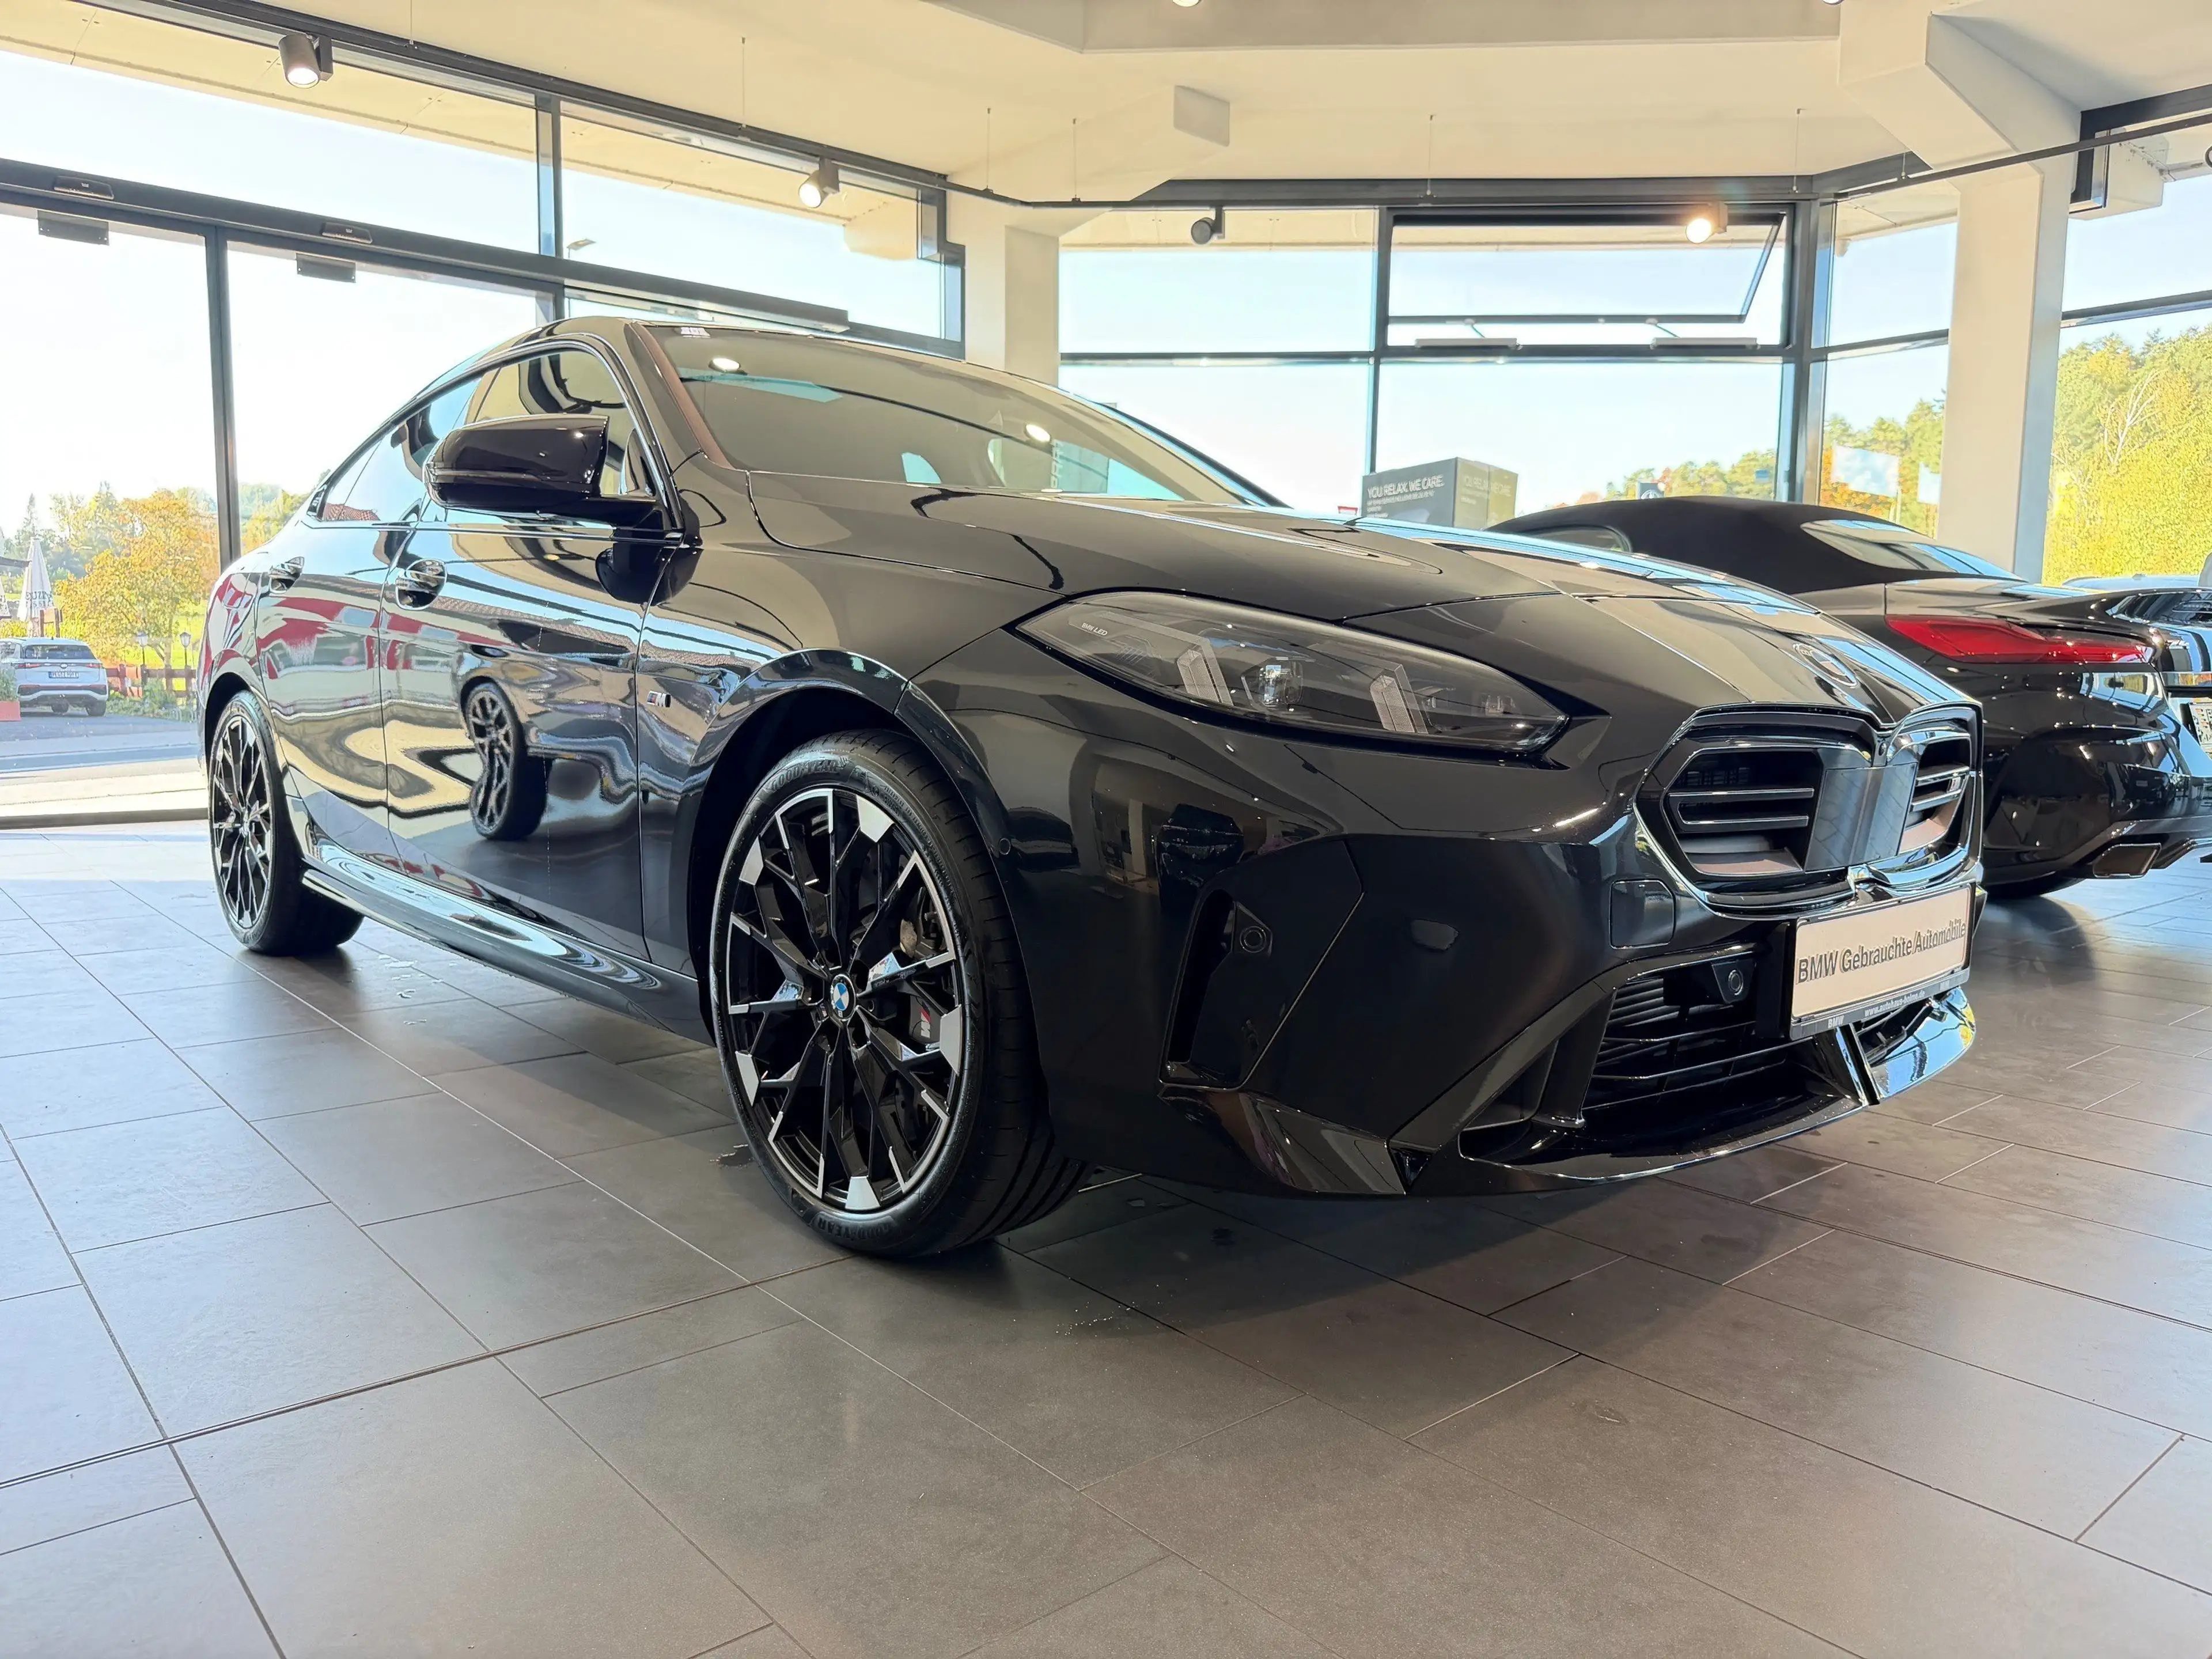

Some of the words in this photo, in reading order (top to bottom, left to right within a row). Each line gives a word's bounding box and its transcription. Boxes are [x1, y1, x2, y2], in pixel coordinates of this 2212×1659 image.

[1367, 486, 1383, 499] YOU
[1408, 478, 1421, 491] WE
[1082, 622, 1094, 631] BMW
[1093, 627, 1108, 636] LED
[1797, 950, 1838, 984] BMW
[1840, 936, 1912, 974] Gebrauchte
[1913, 918, 1966, 955] Automobile
[1827, 1016, 1844, 1029] BMW
